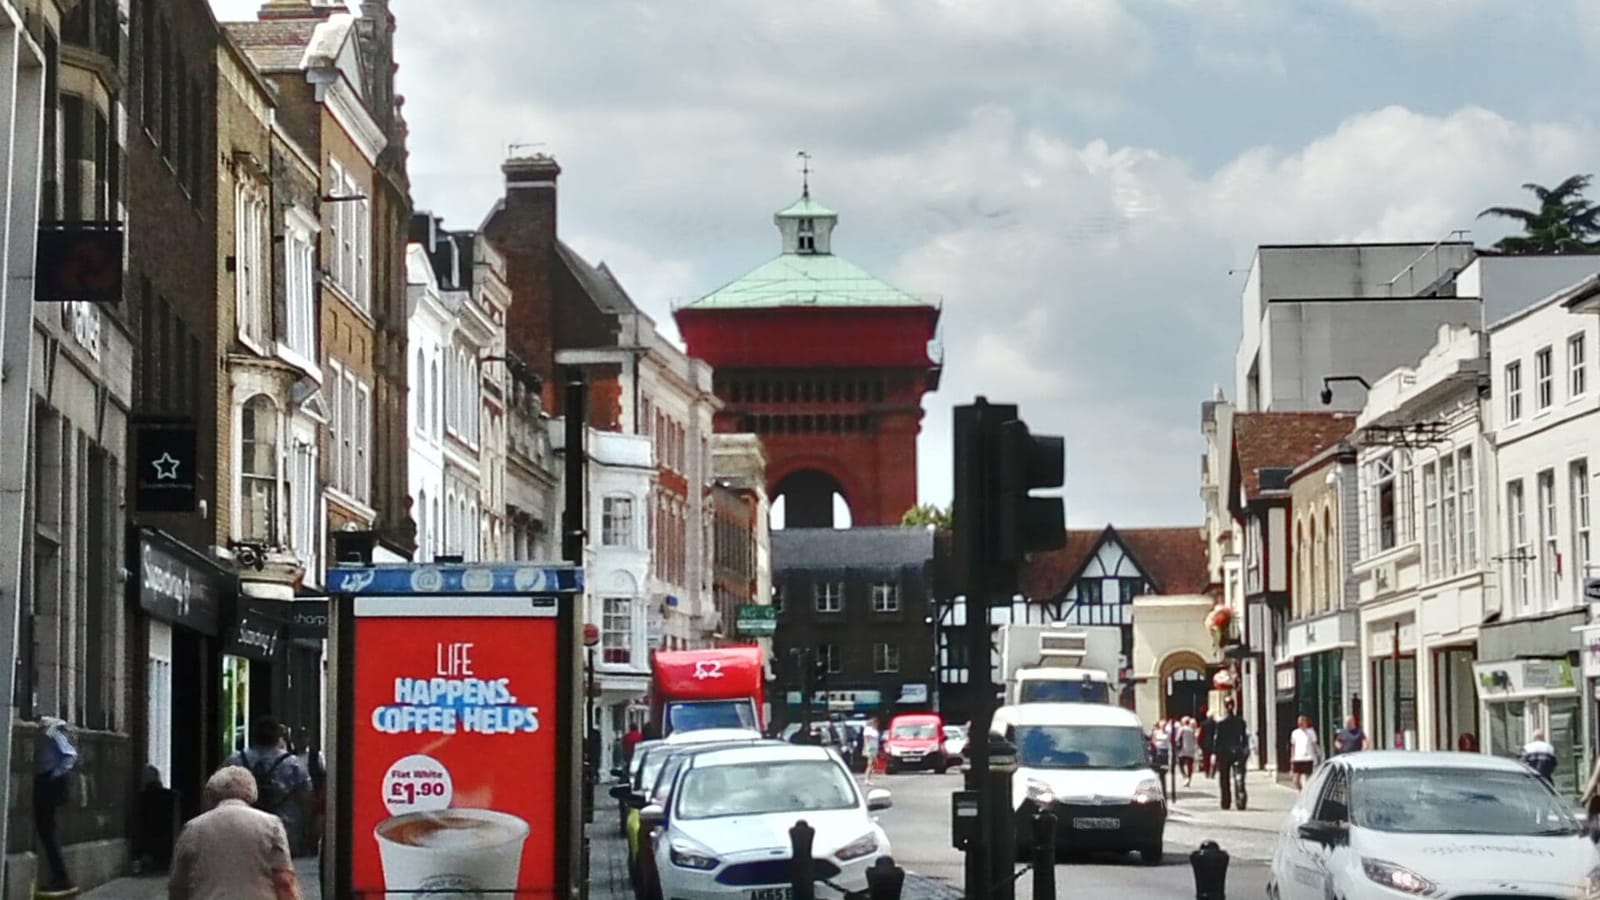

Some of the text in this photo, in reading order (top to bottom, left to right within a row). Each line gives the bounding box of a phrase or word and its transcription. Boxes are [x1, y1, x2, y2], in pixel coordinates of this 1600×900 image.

[437, 643, 474, 675] LIFE
[395, 678, 517, 705] HAPPENS.
[372, 706, 539, 734] COFFEE HELPS
[391, 770, 443, 778] Flat White
[391, 782, 445, 804] £1.90
